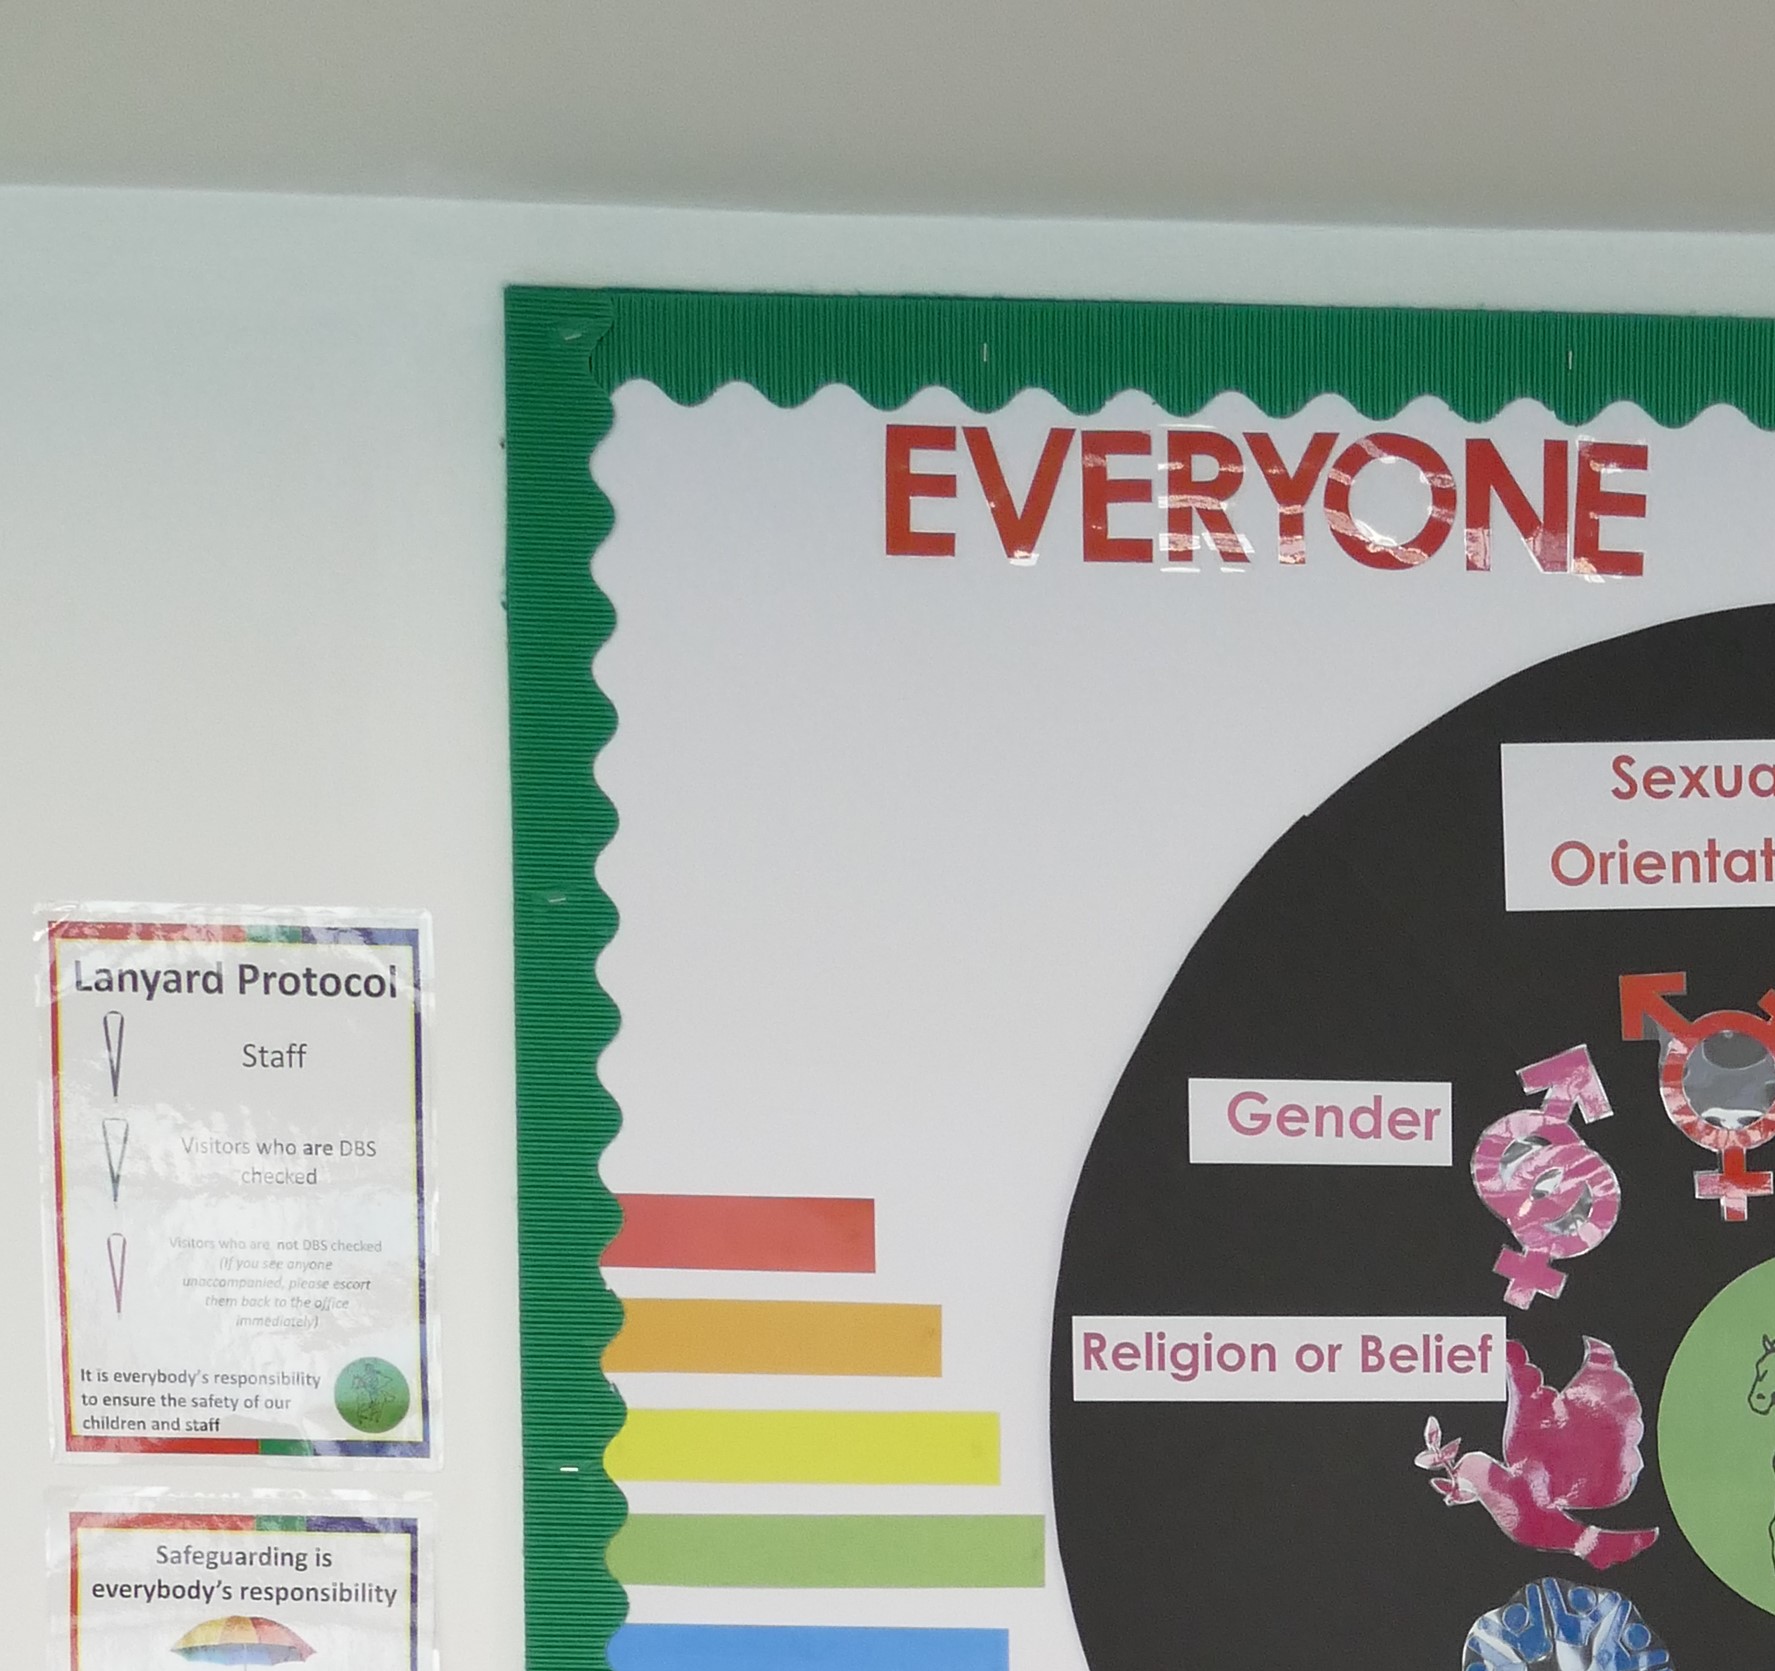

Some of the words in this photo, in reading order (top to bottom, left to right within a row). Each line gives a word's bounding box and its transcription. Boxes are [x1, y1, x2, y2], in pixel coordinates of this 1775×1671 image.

[884, 423, 1650, 580] EVERYONE
[75, 960, 224, 1001] Lanyard
[238, 963, 397, 998] Protocol
[242, 1043, 307, 1068] Staff
[1227, 1091, 1442, 1143] Gender
[181, 1137, 250, 1155] Visitors
[256, 1138, 297, 1155] who
[303, 1142, 333, 1156] are
[340, 1140, 377, 1157] DBS
[241, 1168, 317, 1185] checked
[169, 1237, 215, 1249] Visitors
[218, 1239, 246, 1249] who
[250, 1240, 270, 1250] are
[277, 1240, 299, 1250] not
[303, 1240, 327, 1251] DBS
[330, 1240, 382, 1252] checked
[236, 1258, 259, 1271] you
[263, 1260, 284, 1270] see
[287, 1260, 333, 1272] anyone
[288, 1277, 330, 1291] please
[333, 1280, 372, 1290] escort
[205, 1296, 238, 1307] them
[241, 1296, 271, 1308] back
[275, 1298, 287, 1308] to
[291, 1297, 311, 1309] the
[1081, 1330, 1276, 1381] Religion
[1295, 1337, 1343, 1374] or
[1360, 1334, 1494, 1375] Belief
[80, 1368, 92, 1382] It
[97, 1368, 109, 1382] is
[214, 1371, 321, 1388] responsibility
[82, 1394, 98, 1406] to
[103, 1395, 155, 1407] ensure
[161, 1394, 186, 1407] the
[191, 1394, 239, 1411] safety
[244, 1395, 261, 1409] of
[265, 1398, 291, 1409] our
[83, 1416, 146, 1431] children
[151, 1417, 181, 1431] and
[185, 1418, 220, 1432] staff
[156, 1544, 308, 1571] Safeguarding
[315, 1548, 332, 1567] is
[240, 1582, 398, 1607] responsibility
